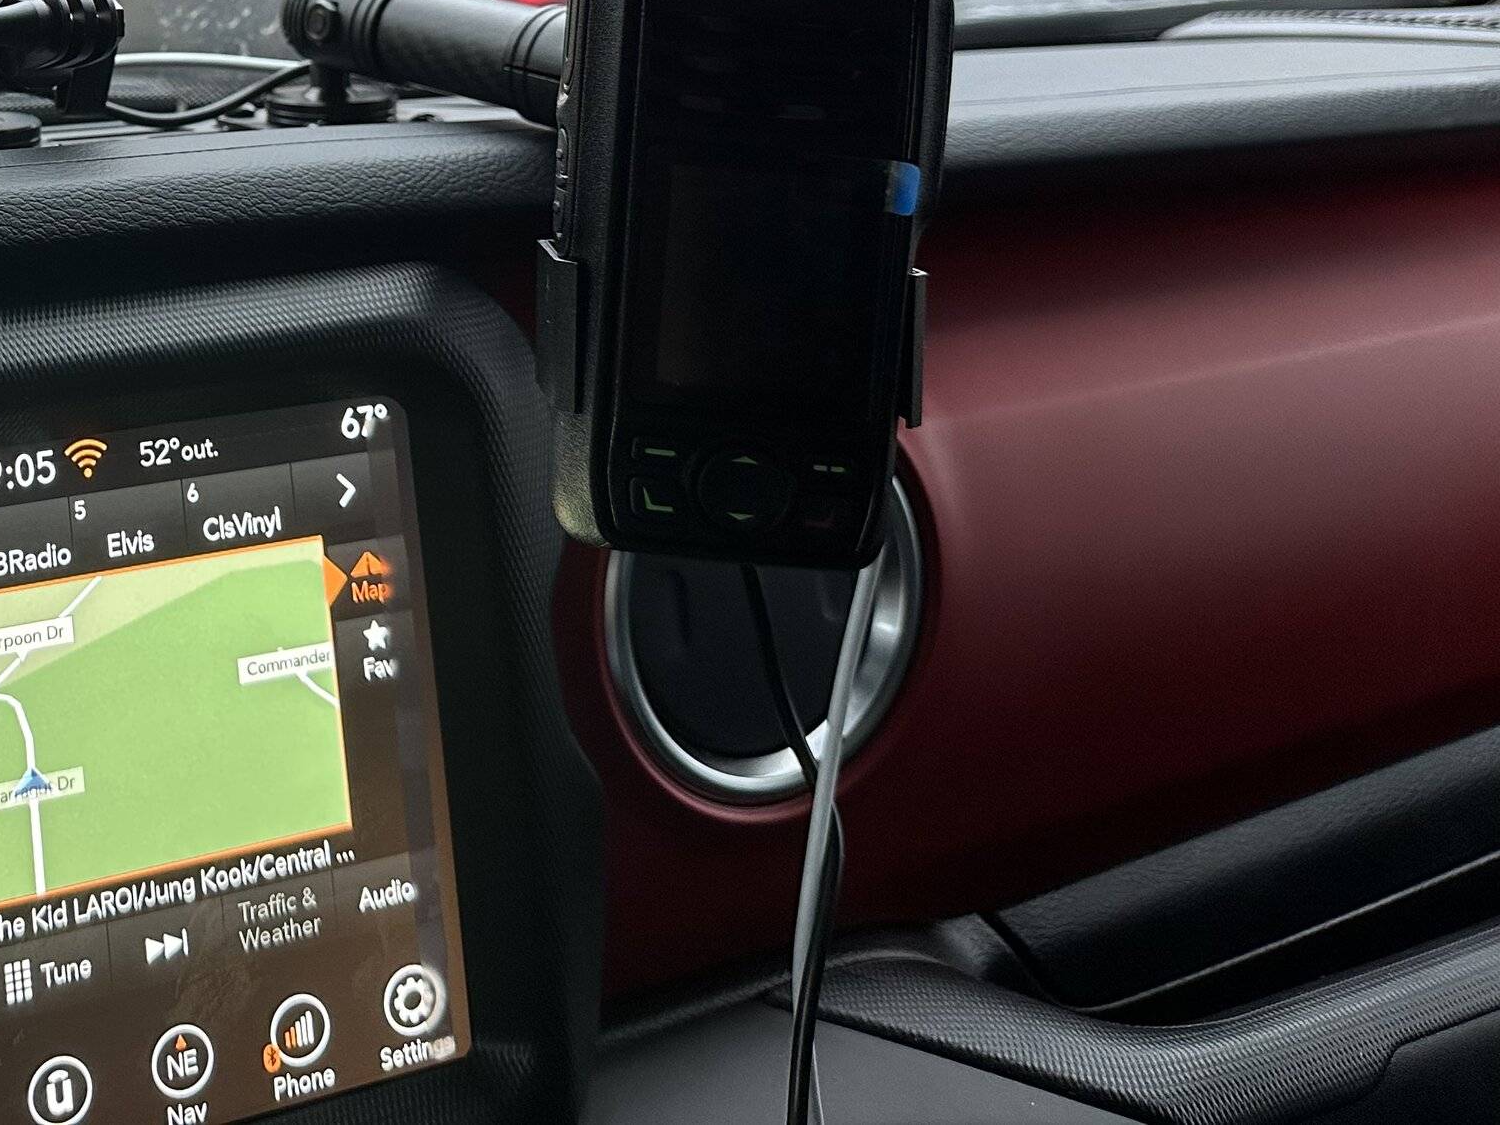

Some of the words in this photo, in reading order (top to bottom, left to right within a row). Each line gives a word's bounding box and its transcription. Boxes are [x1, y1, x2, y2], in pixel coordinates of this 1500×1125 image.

[186, 483, 200, 504] 6
[74, 500, 87, 521] 5
[202, 505, 282, 543] ClsVinyl
[107, 531, 155, 559] Elvis
[351, 579, 393, 606] Map
[47, 625, 65, 643] Dr
[246, 649, 331, 677] Commander
[363, 655, 398, 682] Fav
[57, 776, 76, 792] Dr
[31, 900, 69, 933] Kid
[200, 839, 332, 893] Kook/Central
[358, 877, 417, 913] Audio
[237, 895, 298, 924] Traffic
[302, 885, 318, 908] &
[238, 914, 322, 952] Weather
[40, 955, 93, 988] Tune
[167, 1049, 199, 1079] NE
[273, 1066, 336, 1101] Phone
[166, 1101, 208, 1125] Nav
